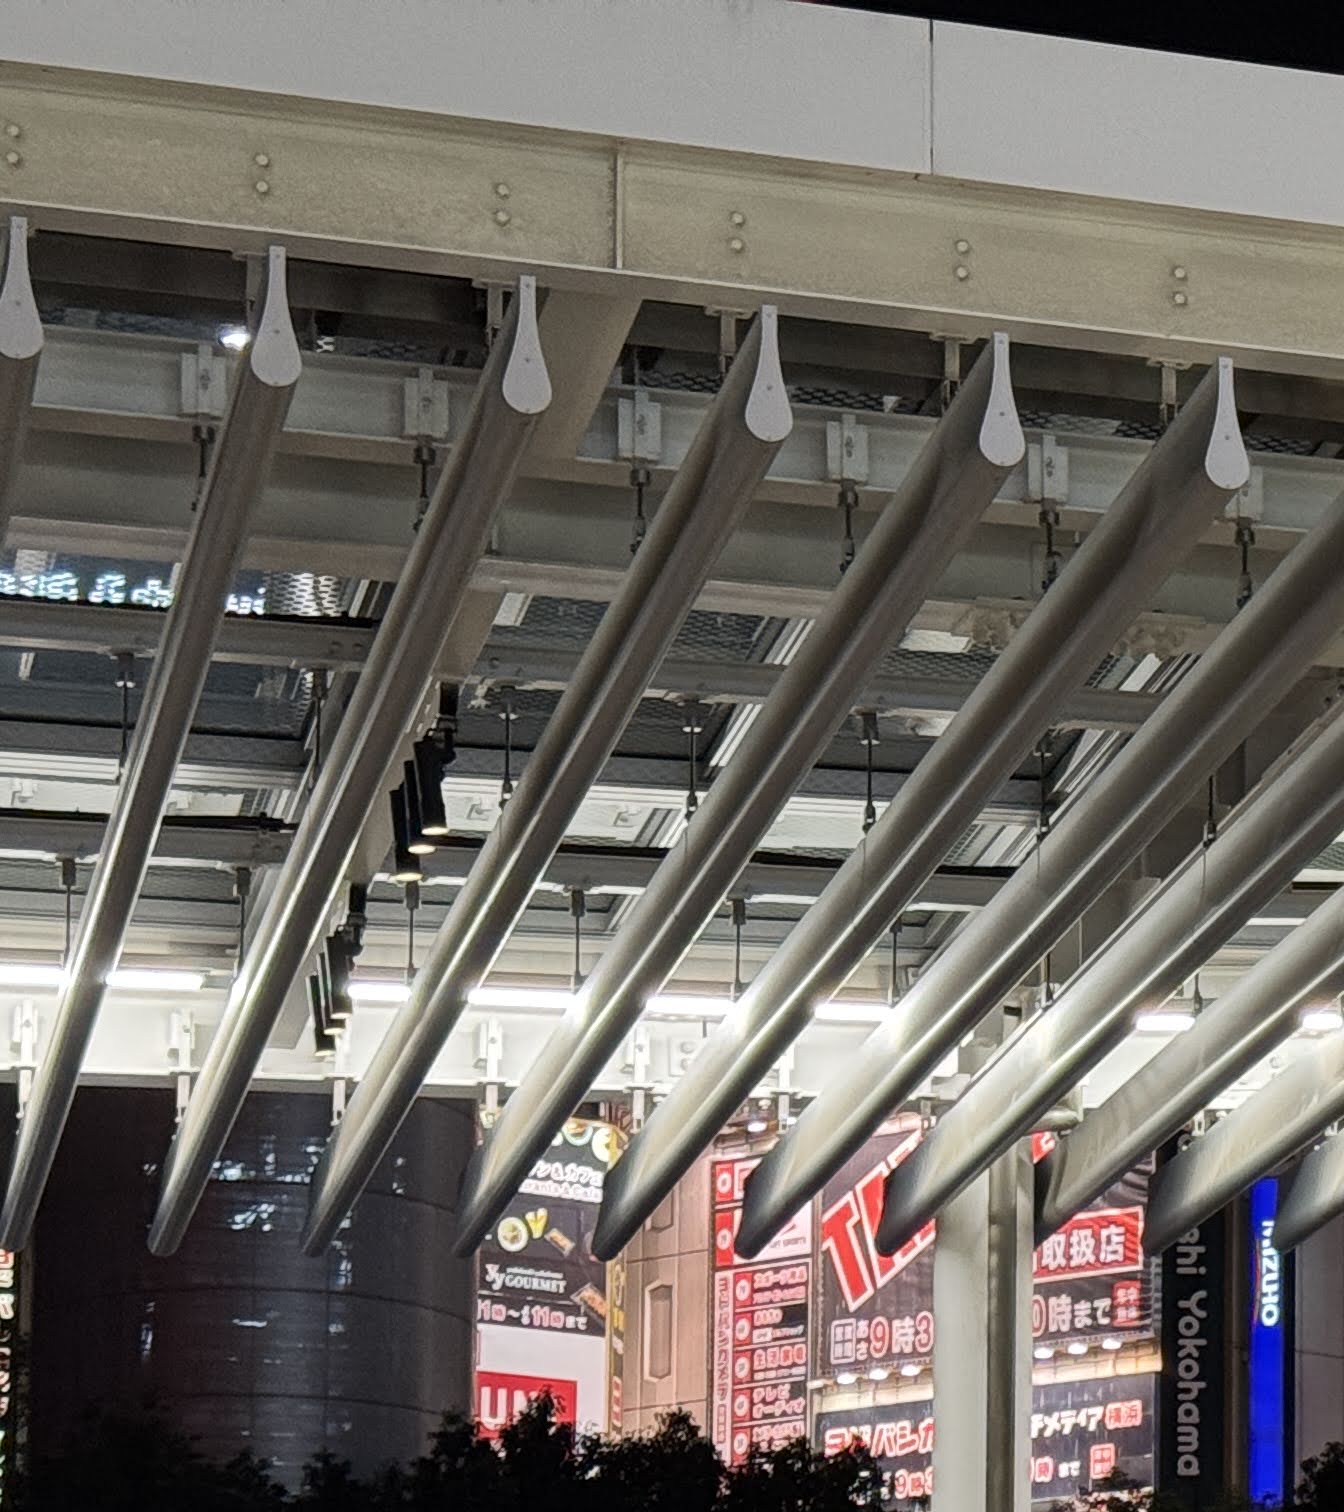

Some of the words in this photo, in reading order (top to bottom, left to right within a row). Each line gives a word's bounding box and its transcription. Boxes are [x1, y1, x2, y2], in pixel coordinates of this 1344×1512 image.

[1033, 1222, 1127, 1271] 取扱店
[504, 1274, 567, 1294] GOURMET
[1177, 1290, 1208, 1477] Yokohama
